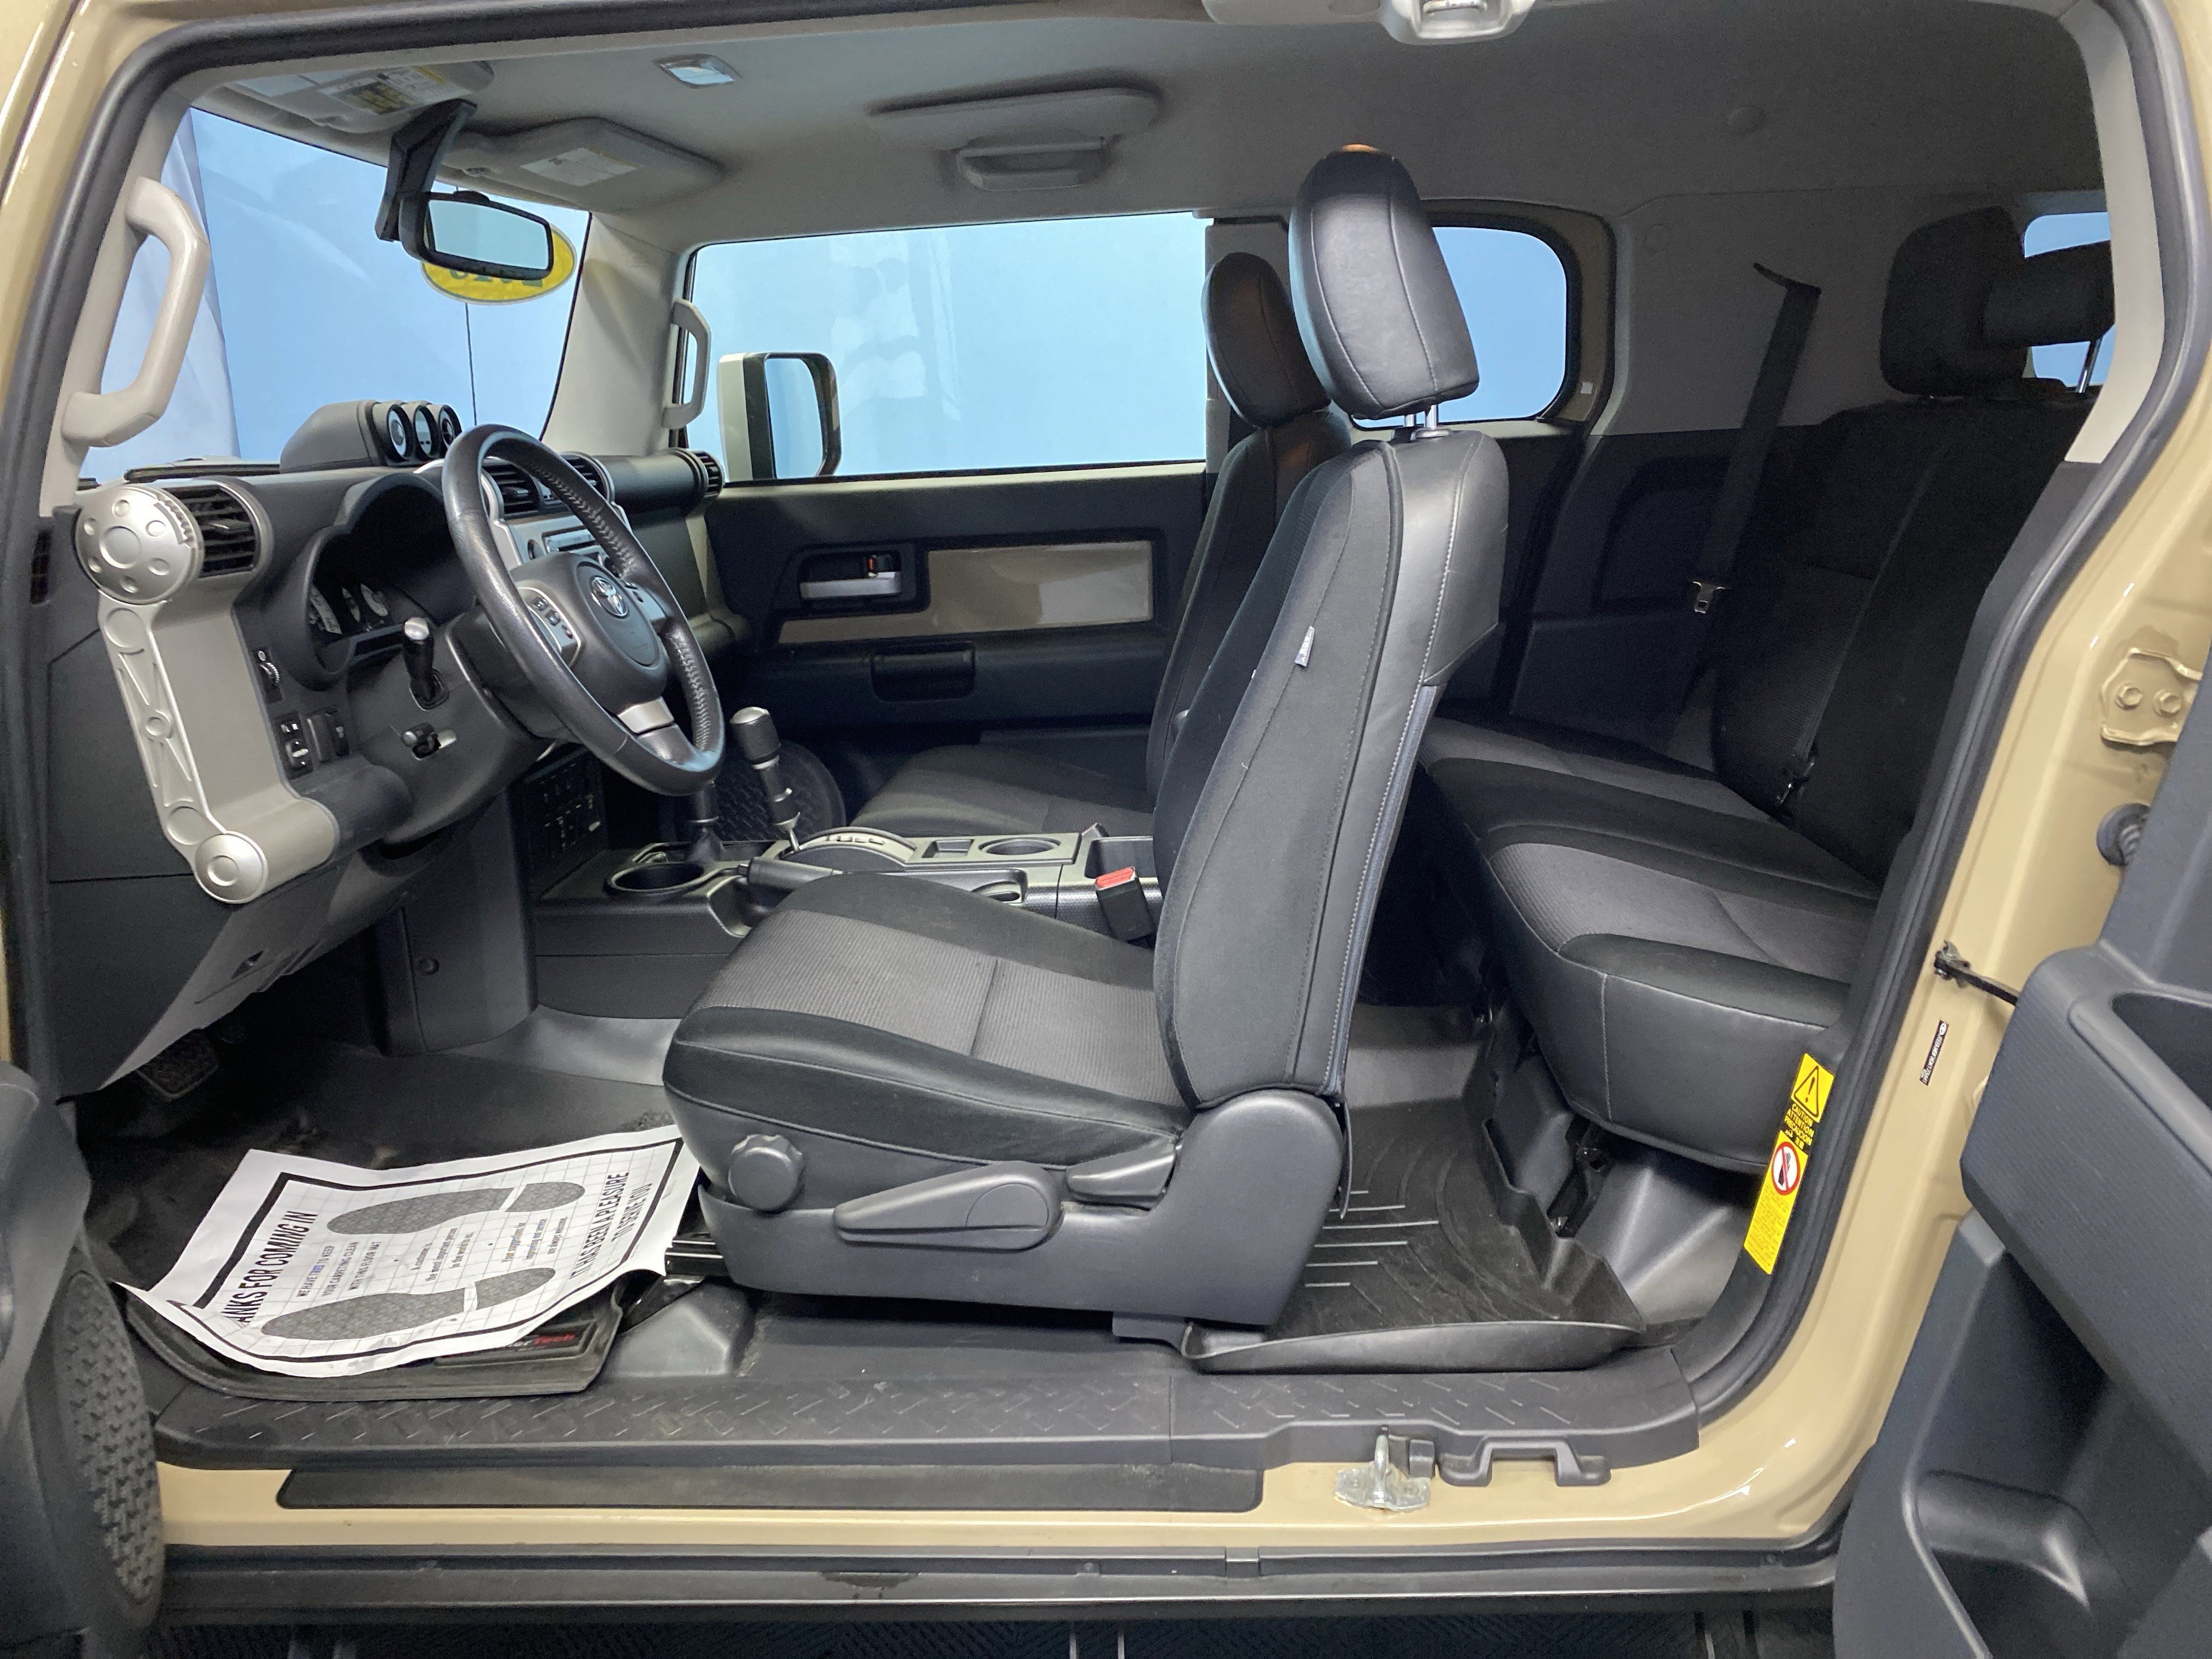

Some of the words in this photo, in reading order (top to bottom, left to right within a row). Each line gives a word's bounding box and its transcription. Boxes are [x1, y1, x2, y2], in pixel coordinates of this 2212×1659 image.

[1787, 1108, 1815, 1138] ATTENTION
[1792, 1103, 1813, 1127] CAUTION
[595, 1172, 629, 1217] PLEASURE
[627, 1183, 652, 1205] YOU
[283, 1211, 318, 1224] IN
[592, 1214, 615, 1224] A
[617, 1198, 646, 1229] SERVE
[255, 1223, 309, 1265] COMING
[583, 1222, 612, 1250] BEEN
[611, 1223, 635, 1243] TO
[360, 1251, 376, 1267] FLOOR
[574, 1244, 602, 1269] HAS
[238, 1269, 284, 1289] FOR
[330, 1257, 352, 1284] CARPETING
[569, 1263, 592, 1279] IT
[301, 1277, 318, 1289] HAVE
[221, 1291, 268, 1323] ANKS
